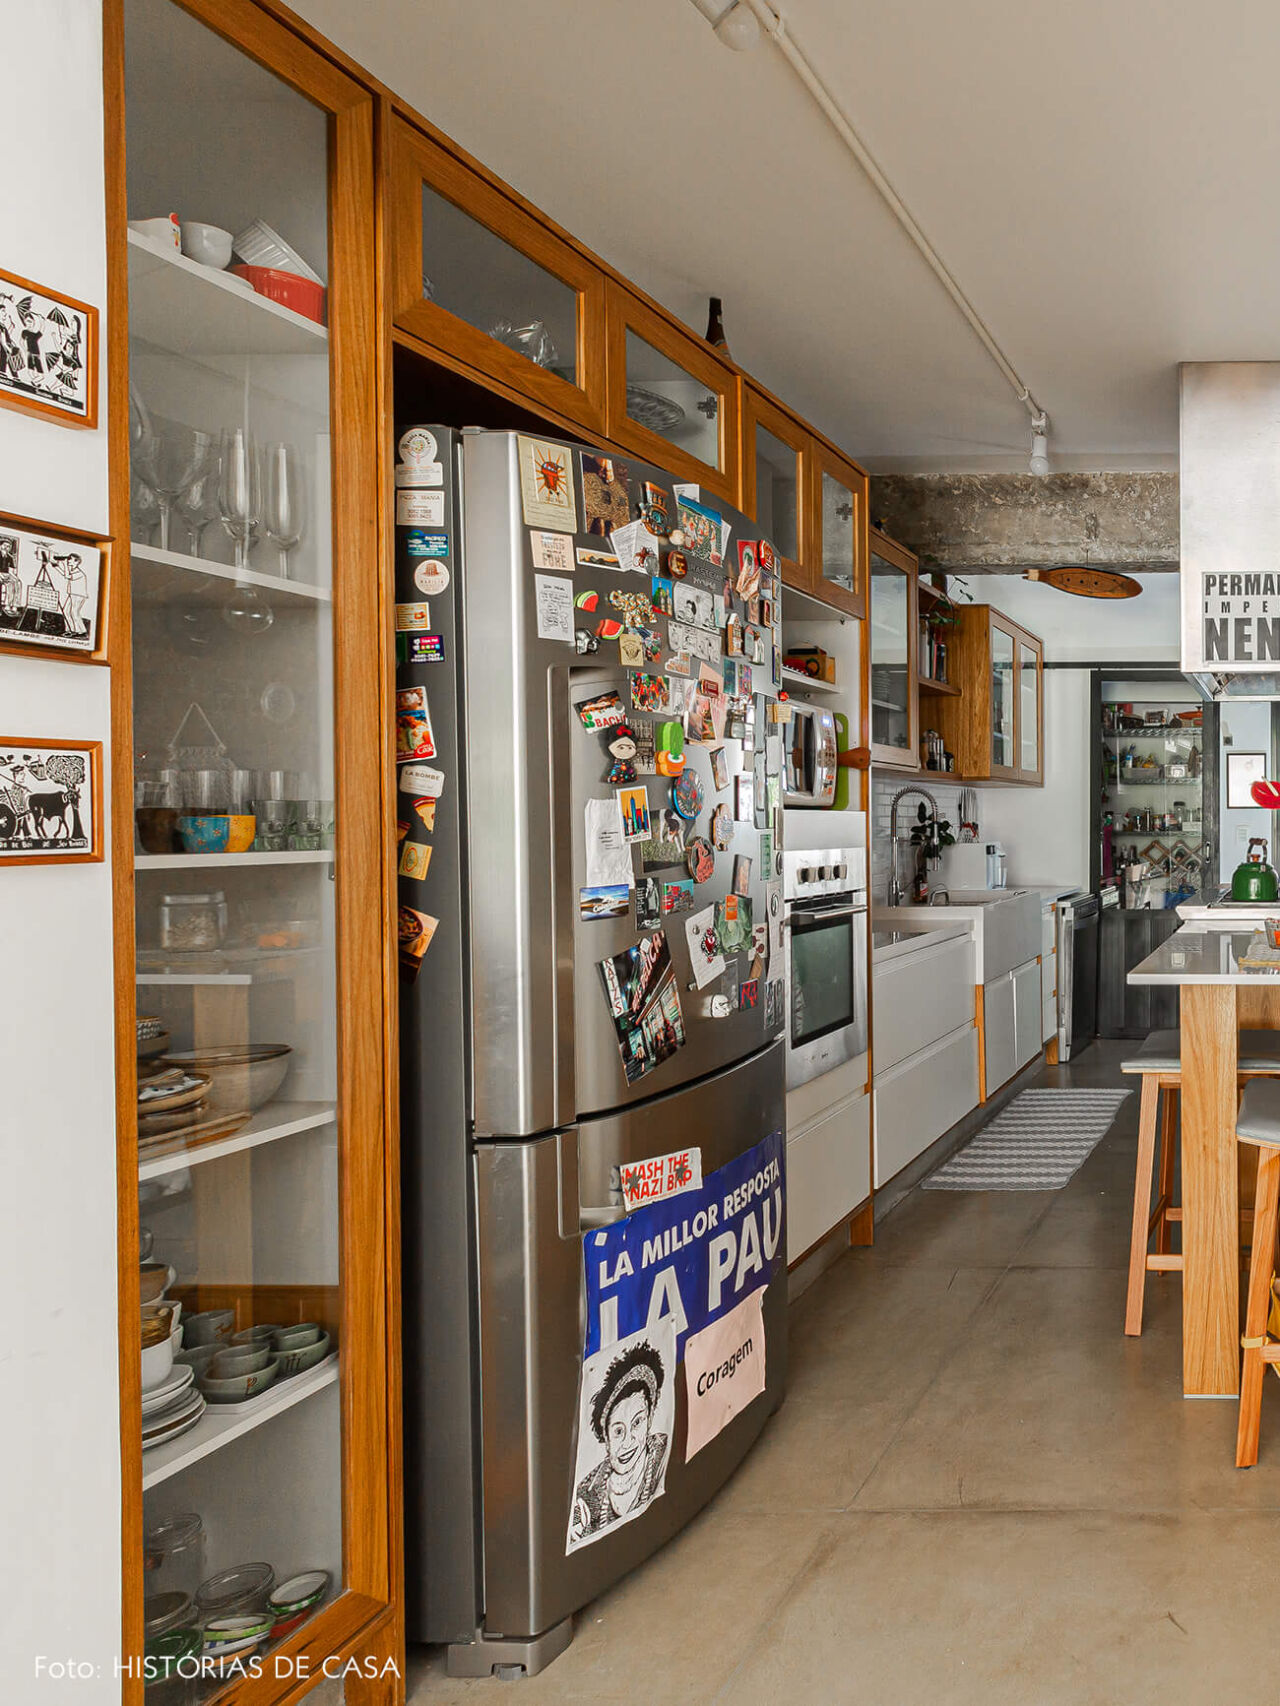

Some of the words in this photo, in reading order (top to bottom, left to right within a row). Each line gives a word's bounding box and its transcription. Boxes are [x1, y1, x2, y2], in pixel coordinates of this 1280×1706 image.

[630, 1178, 663, 1202] NAZI
[668, 1153, 689, 1174] THE
[600, 1251, 634, 1289] LA
[641, 1204, 718, 1269] MILLOR
[723, 1157, 780, 1222] RESPOSTA
[708, 1184, 781, 1313] PAU
[696, 1336, 753, 1398] Coragem
